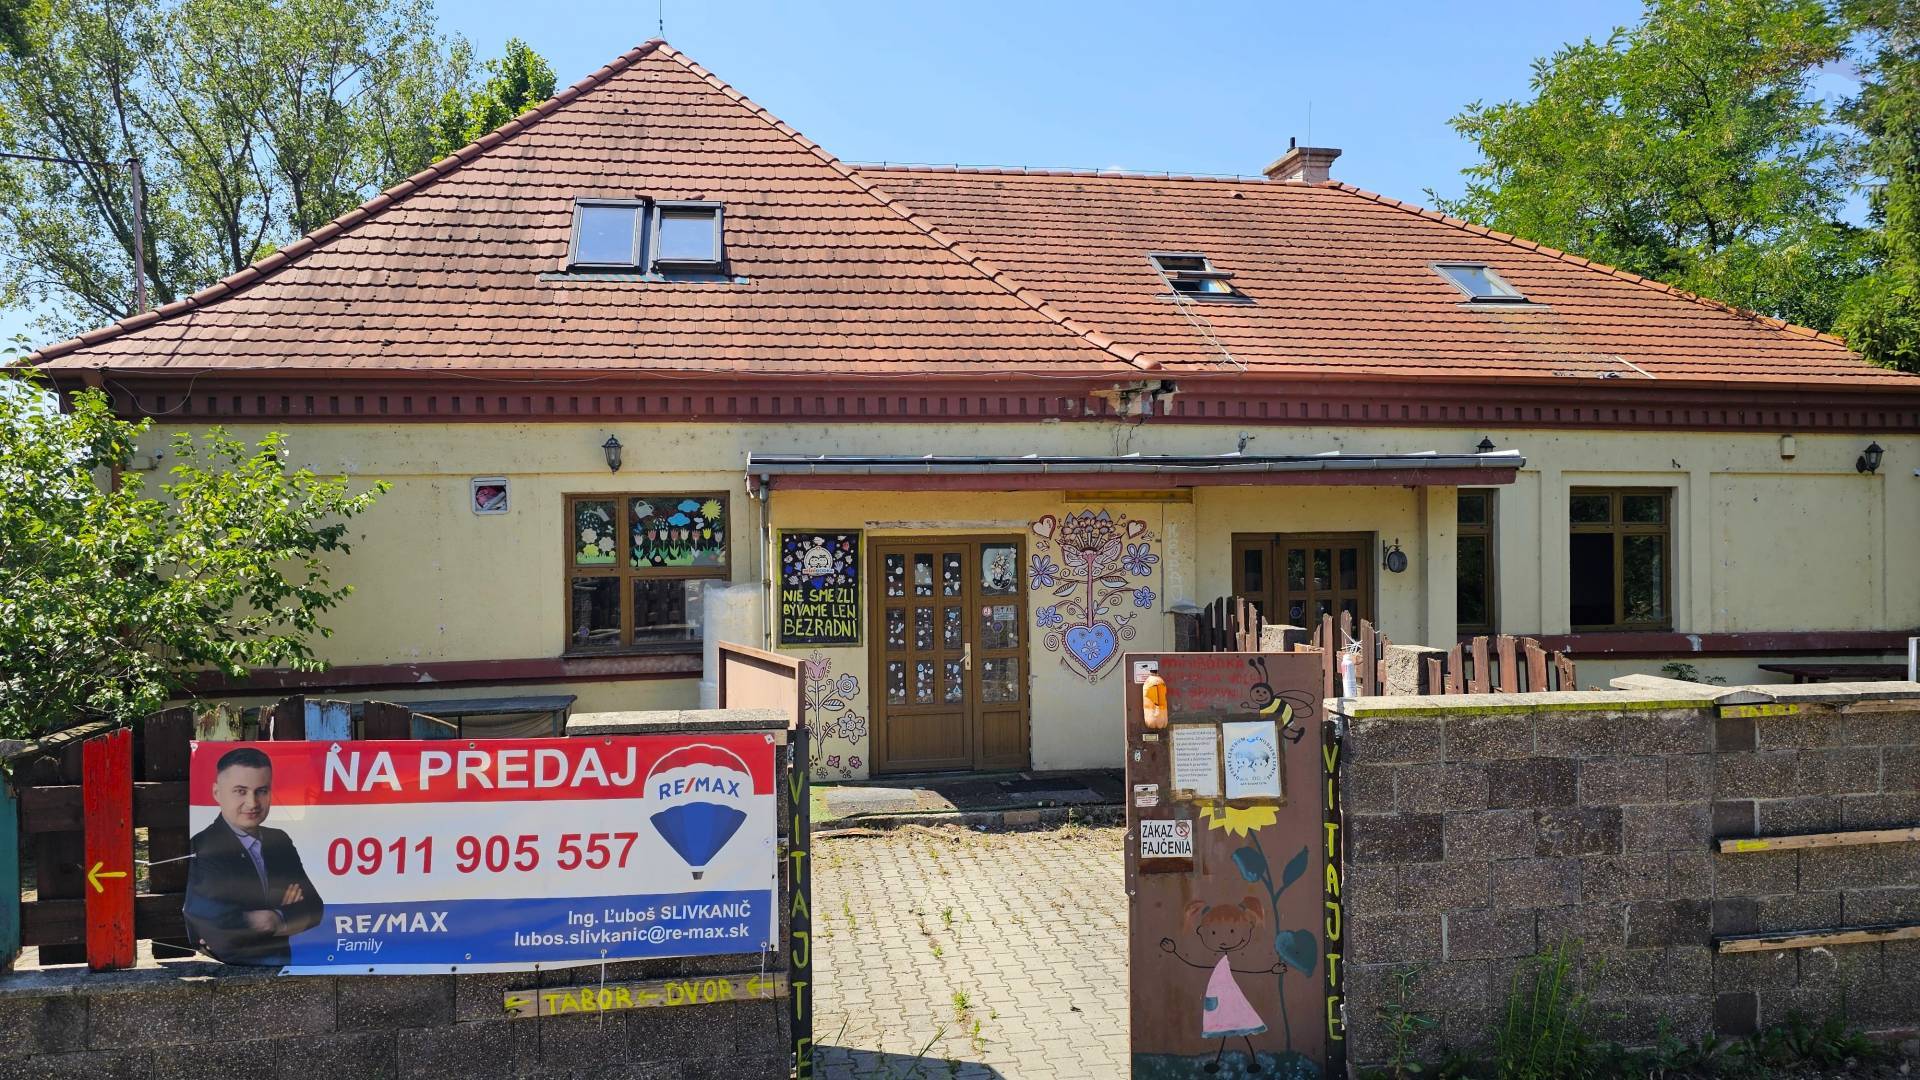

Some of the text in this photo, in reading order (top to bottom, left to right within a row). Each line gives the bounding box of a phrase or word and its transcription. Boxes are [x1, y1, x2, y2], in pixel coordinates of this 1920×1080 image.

[783, 590, 804, 602] NIE
[809, 588, 835, 602] SME
[832, 604, 856, 619] LEN
[323, 746, 637, 792] NA PREDAJ
[659, 776, 740, 801] RE/MAX
[1142, 821, 1173, 838] ZÁKAZ
[327, 832, 639, 876] 0911 905 557
[1142, 838, 1192, 855] FAJČENIA
[1323, 743, 1344, 1042] VITAJTE
[335, 911, 449, 934] RE/MAX
[568, 899, 752, 928] Ing. Ľuboš SLIVKANIČ
[336, 938, 383, 954] Family
[514, 923, 750, 947] lubos.slivkanic@re-max.sk
[542, 977, 736, 1015] TABOR DVOR
